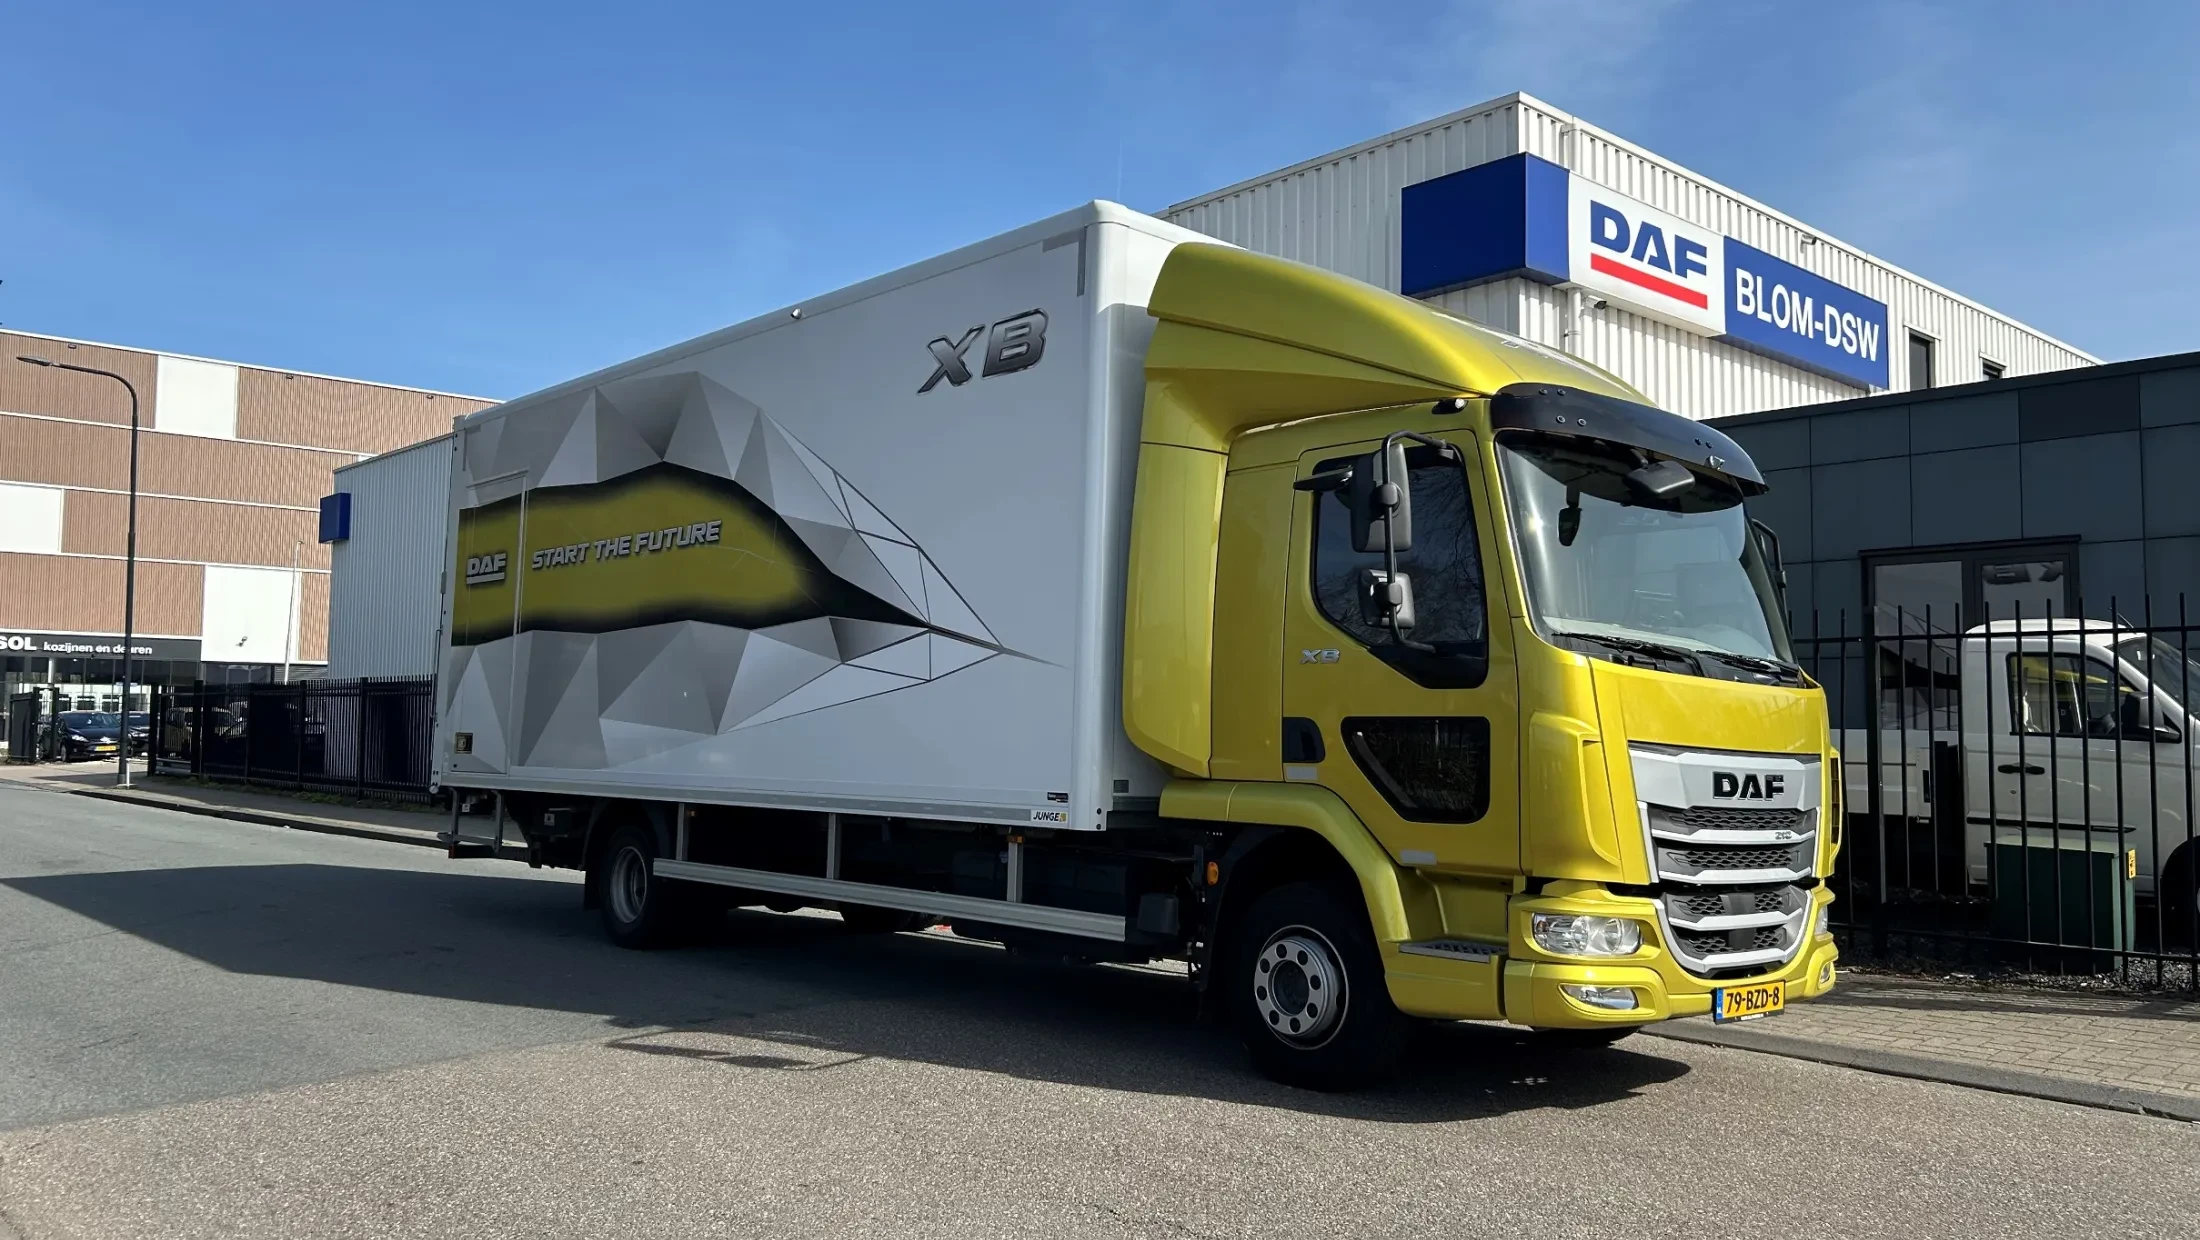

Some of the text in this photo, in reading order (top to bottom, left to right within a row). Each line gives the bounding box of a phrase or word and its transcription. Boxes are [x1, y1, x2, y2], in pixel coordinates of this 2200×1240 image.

[1590, 200, 1707, 279] DAF
[1736, 267, 1879, 362] BLOM-DSW
[917, 308, 1048, 395] XB
[532, 520, 722, 569] START THE FUTURE
[467, 554, 506, 576] DAF
[43, 642, 93, 653] kozijnen
[95, 645, 110, 653] en
[1300, 649, 1340, 664] XB
[1713, 772, 1784, 799] DAF
[1033, 812, 1060, 822] JUNGE
[1726, 986, 1780, 1014] 79-BZD-8
